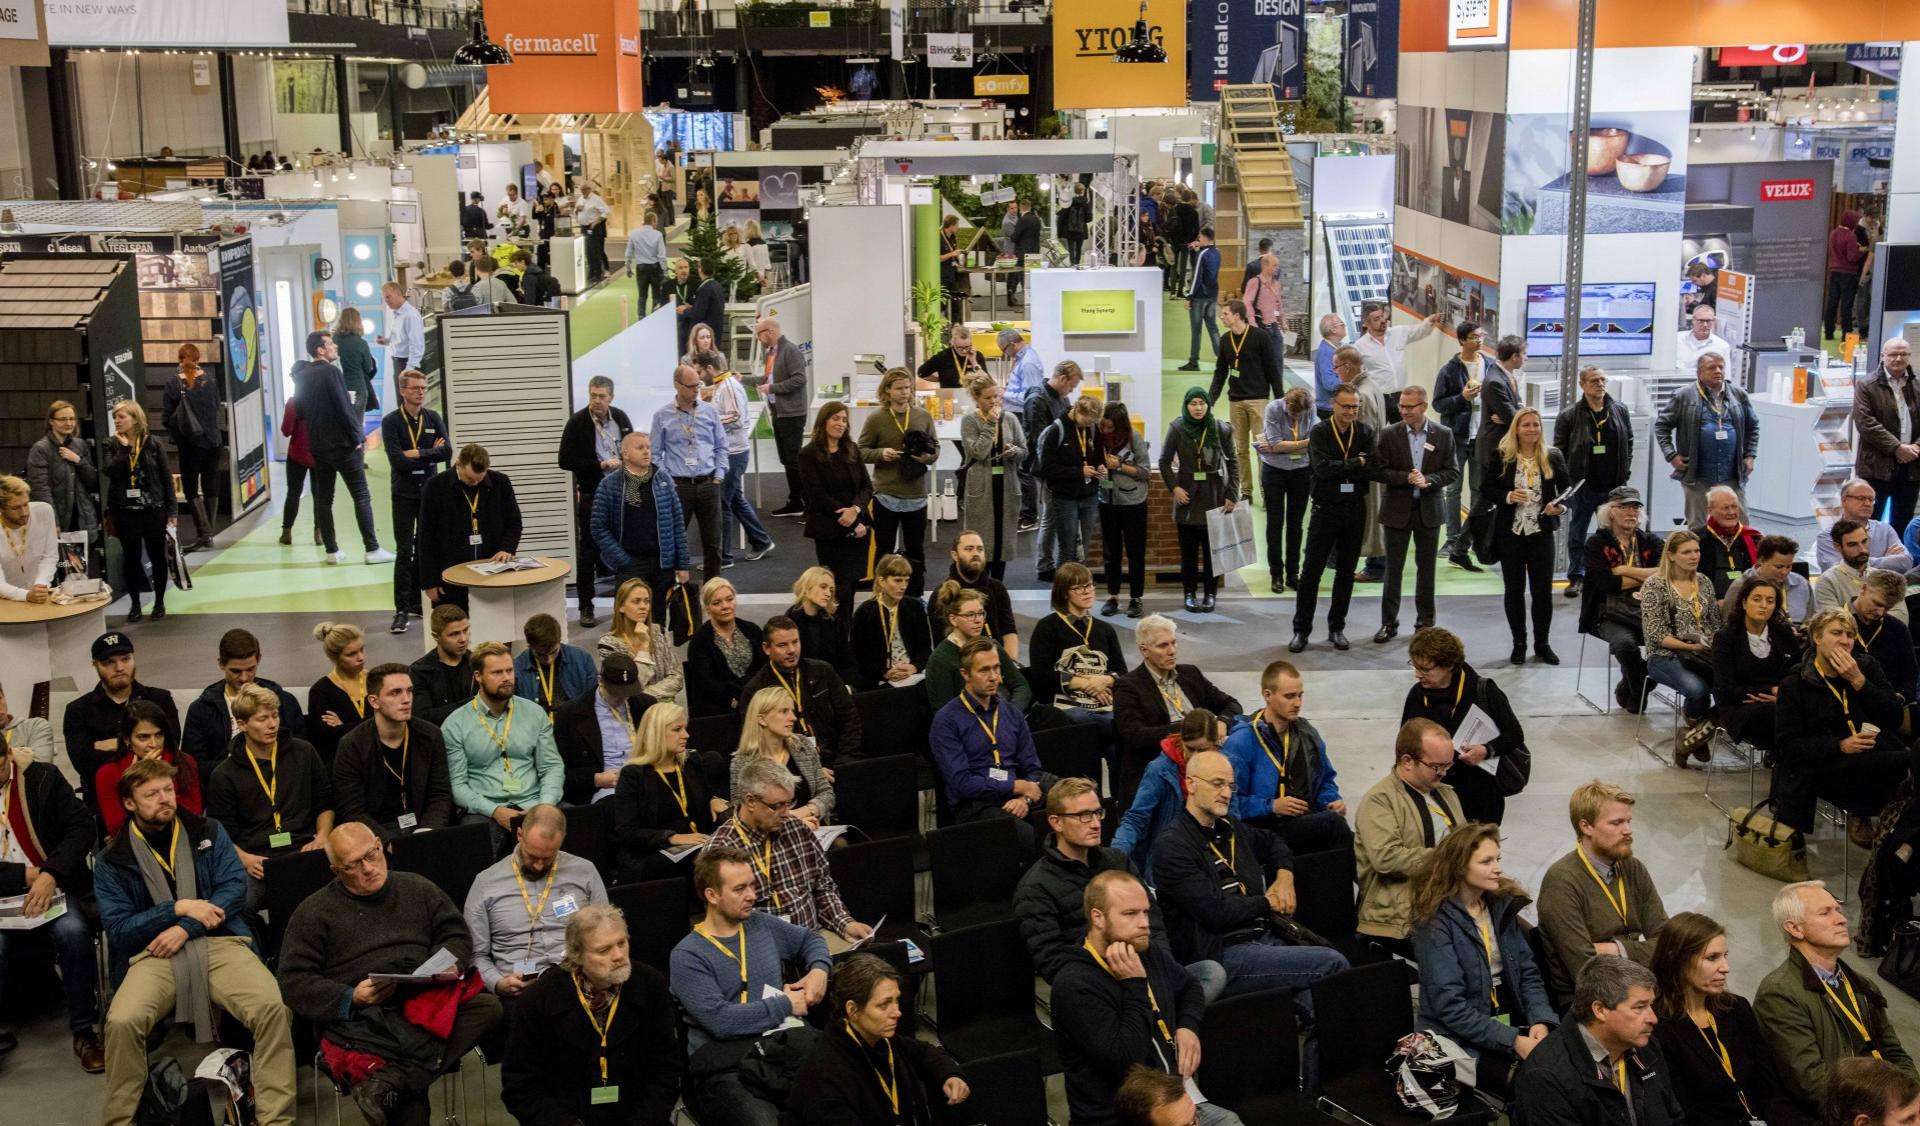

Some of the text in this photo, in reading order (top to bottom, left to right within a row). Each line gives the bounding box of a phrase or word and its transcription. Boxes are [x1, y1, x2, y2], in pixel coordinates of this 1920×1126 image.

[76, 4, 105, 14] NEW
[107, 4, 136, 15] WAYS
[1255, 0, 1299, 16] DESIGN
[504, 33, 598, 52] fermacell
[978, 80, 1024, 94] somfy
[1765, 183, 1812, 197] VELUX
[109, 242, 154, 253] TEGLSPAN
